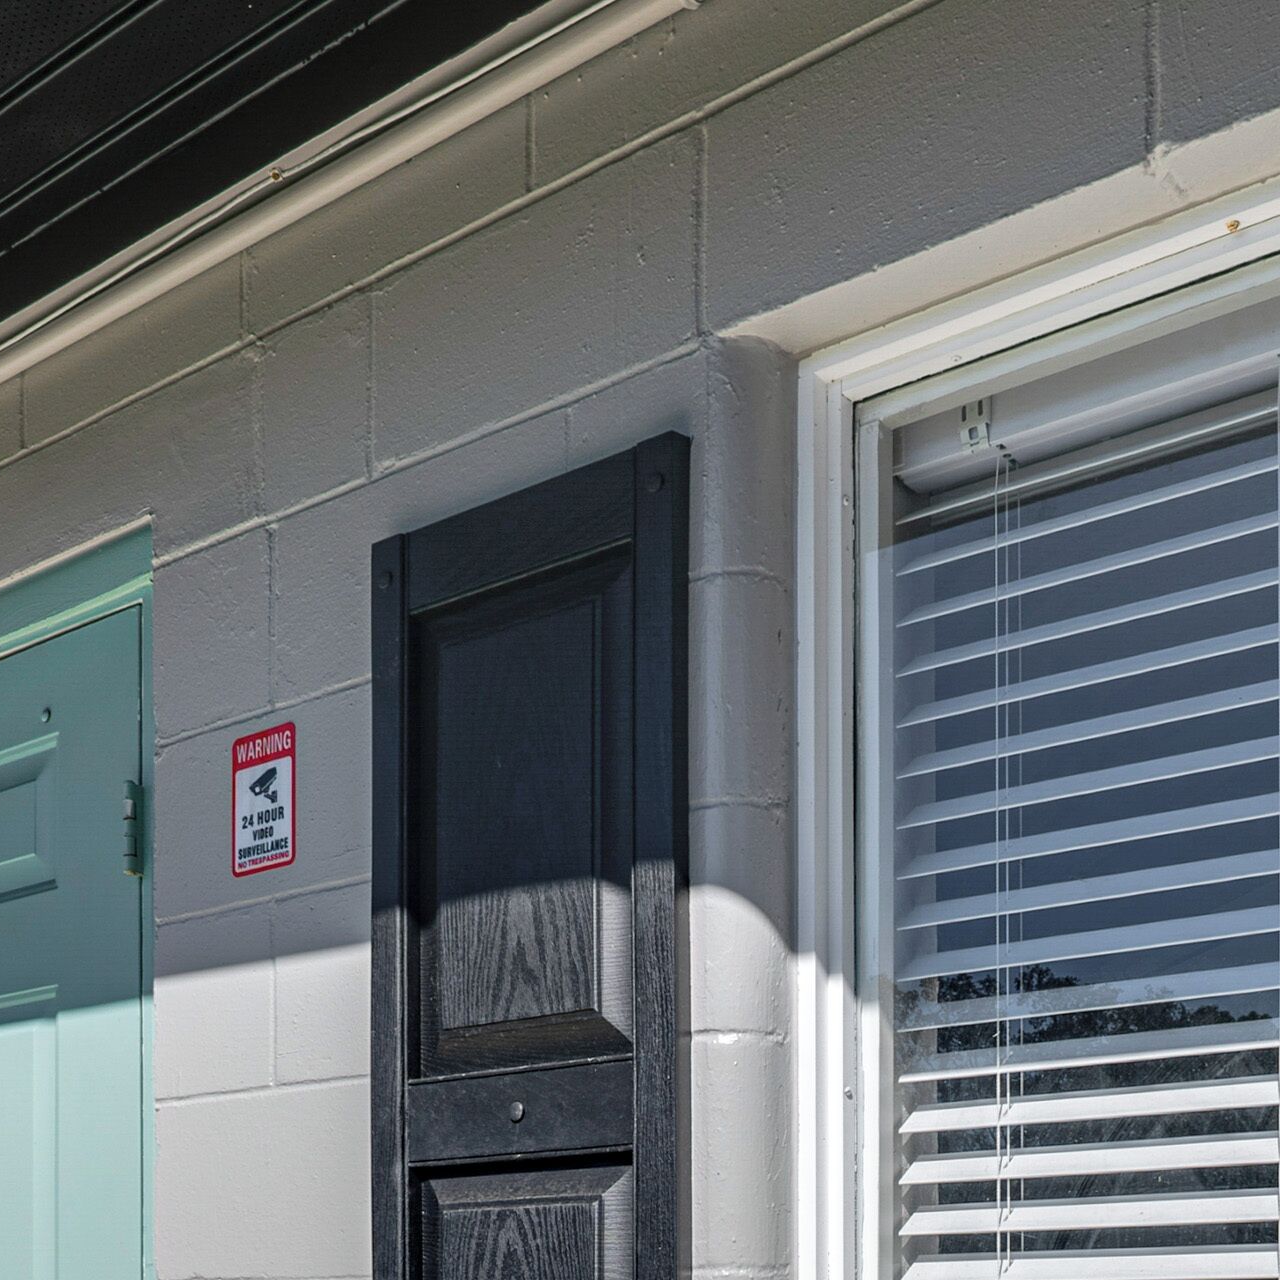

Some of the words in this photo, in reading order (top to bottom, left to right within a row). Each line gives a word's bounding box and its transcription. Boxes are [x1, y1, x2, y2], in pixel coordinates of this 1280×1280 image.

[236, 730, 291, 764] WARNING
[242, 814, 254, 829] 24
[257, 806, 284, 825] HOUR
[253, 825, 274, 841] VIDEO
[237, 861, 247, 870] NO
[248, 850, 289, 866] TRESPASSING
[238, 837, 288, 860] SURVEILLANCE
